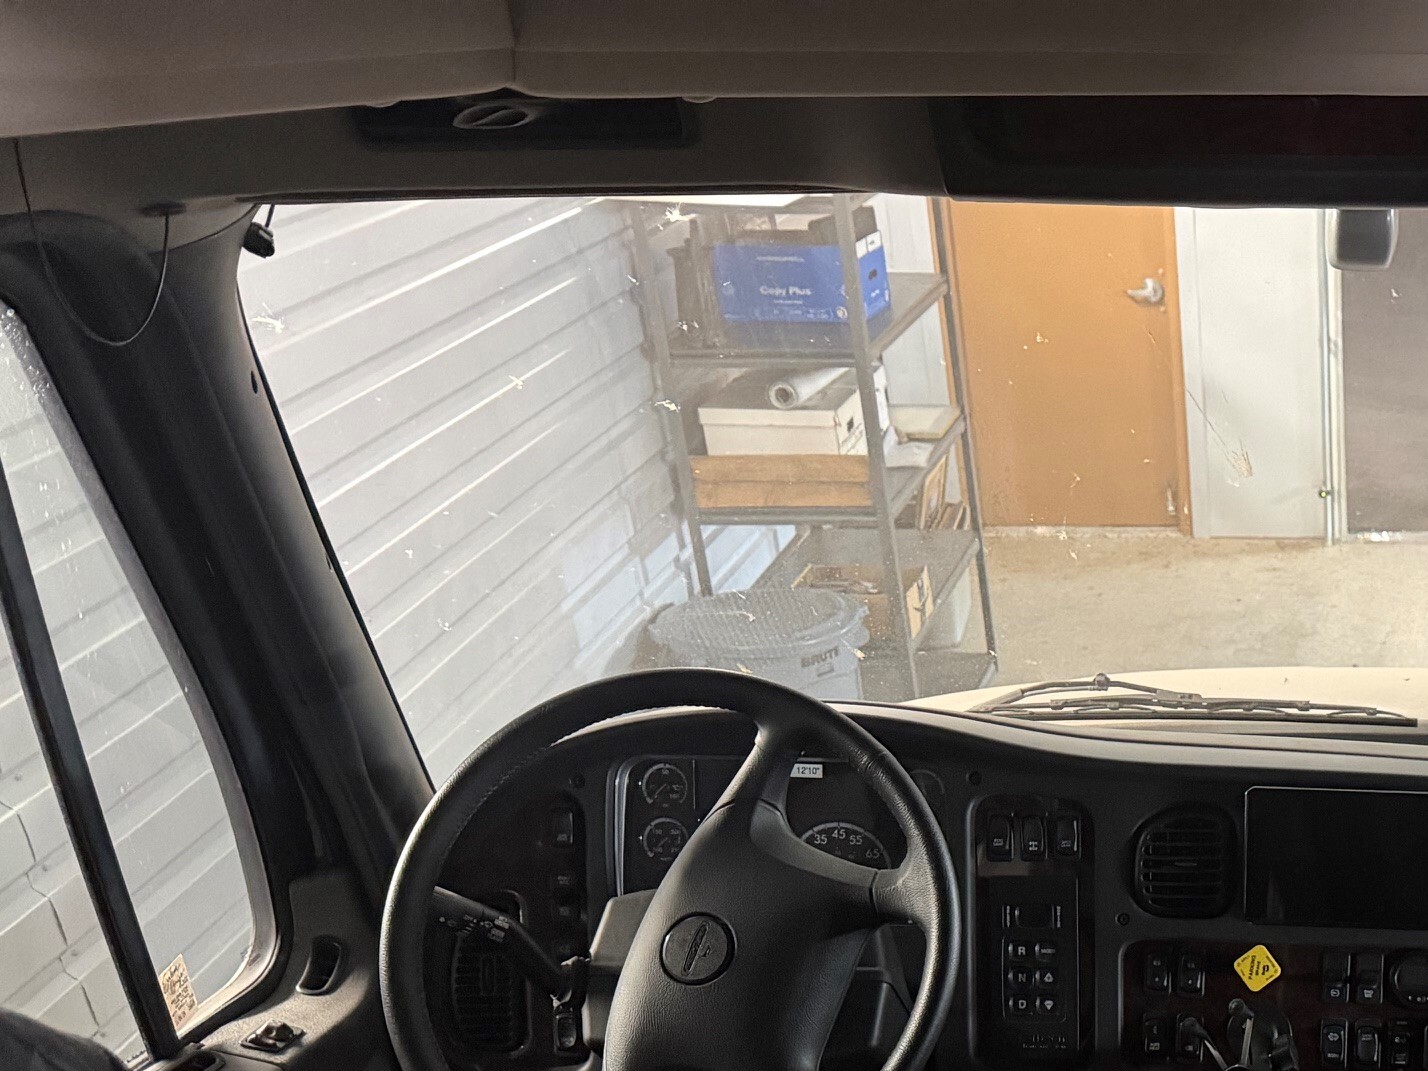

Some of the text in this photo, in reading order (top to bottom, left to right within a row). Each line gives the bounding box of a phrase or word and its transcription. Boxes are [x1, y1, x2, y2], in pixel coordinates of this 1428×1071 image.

[760, 286, 812, 296] Copy Plus
[814, 834, 827, 844] 35
[832, 829, 846, 839] 45
[849, 835, 863, 845] 55
[865, 848, 879, 859] 65
[1018, 946, 1026, 955] R
[1018, 973, 1027, 982] N
[1018, 999, 1027, 1009] D
